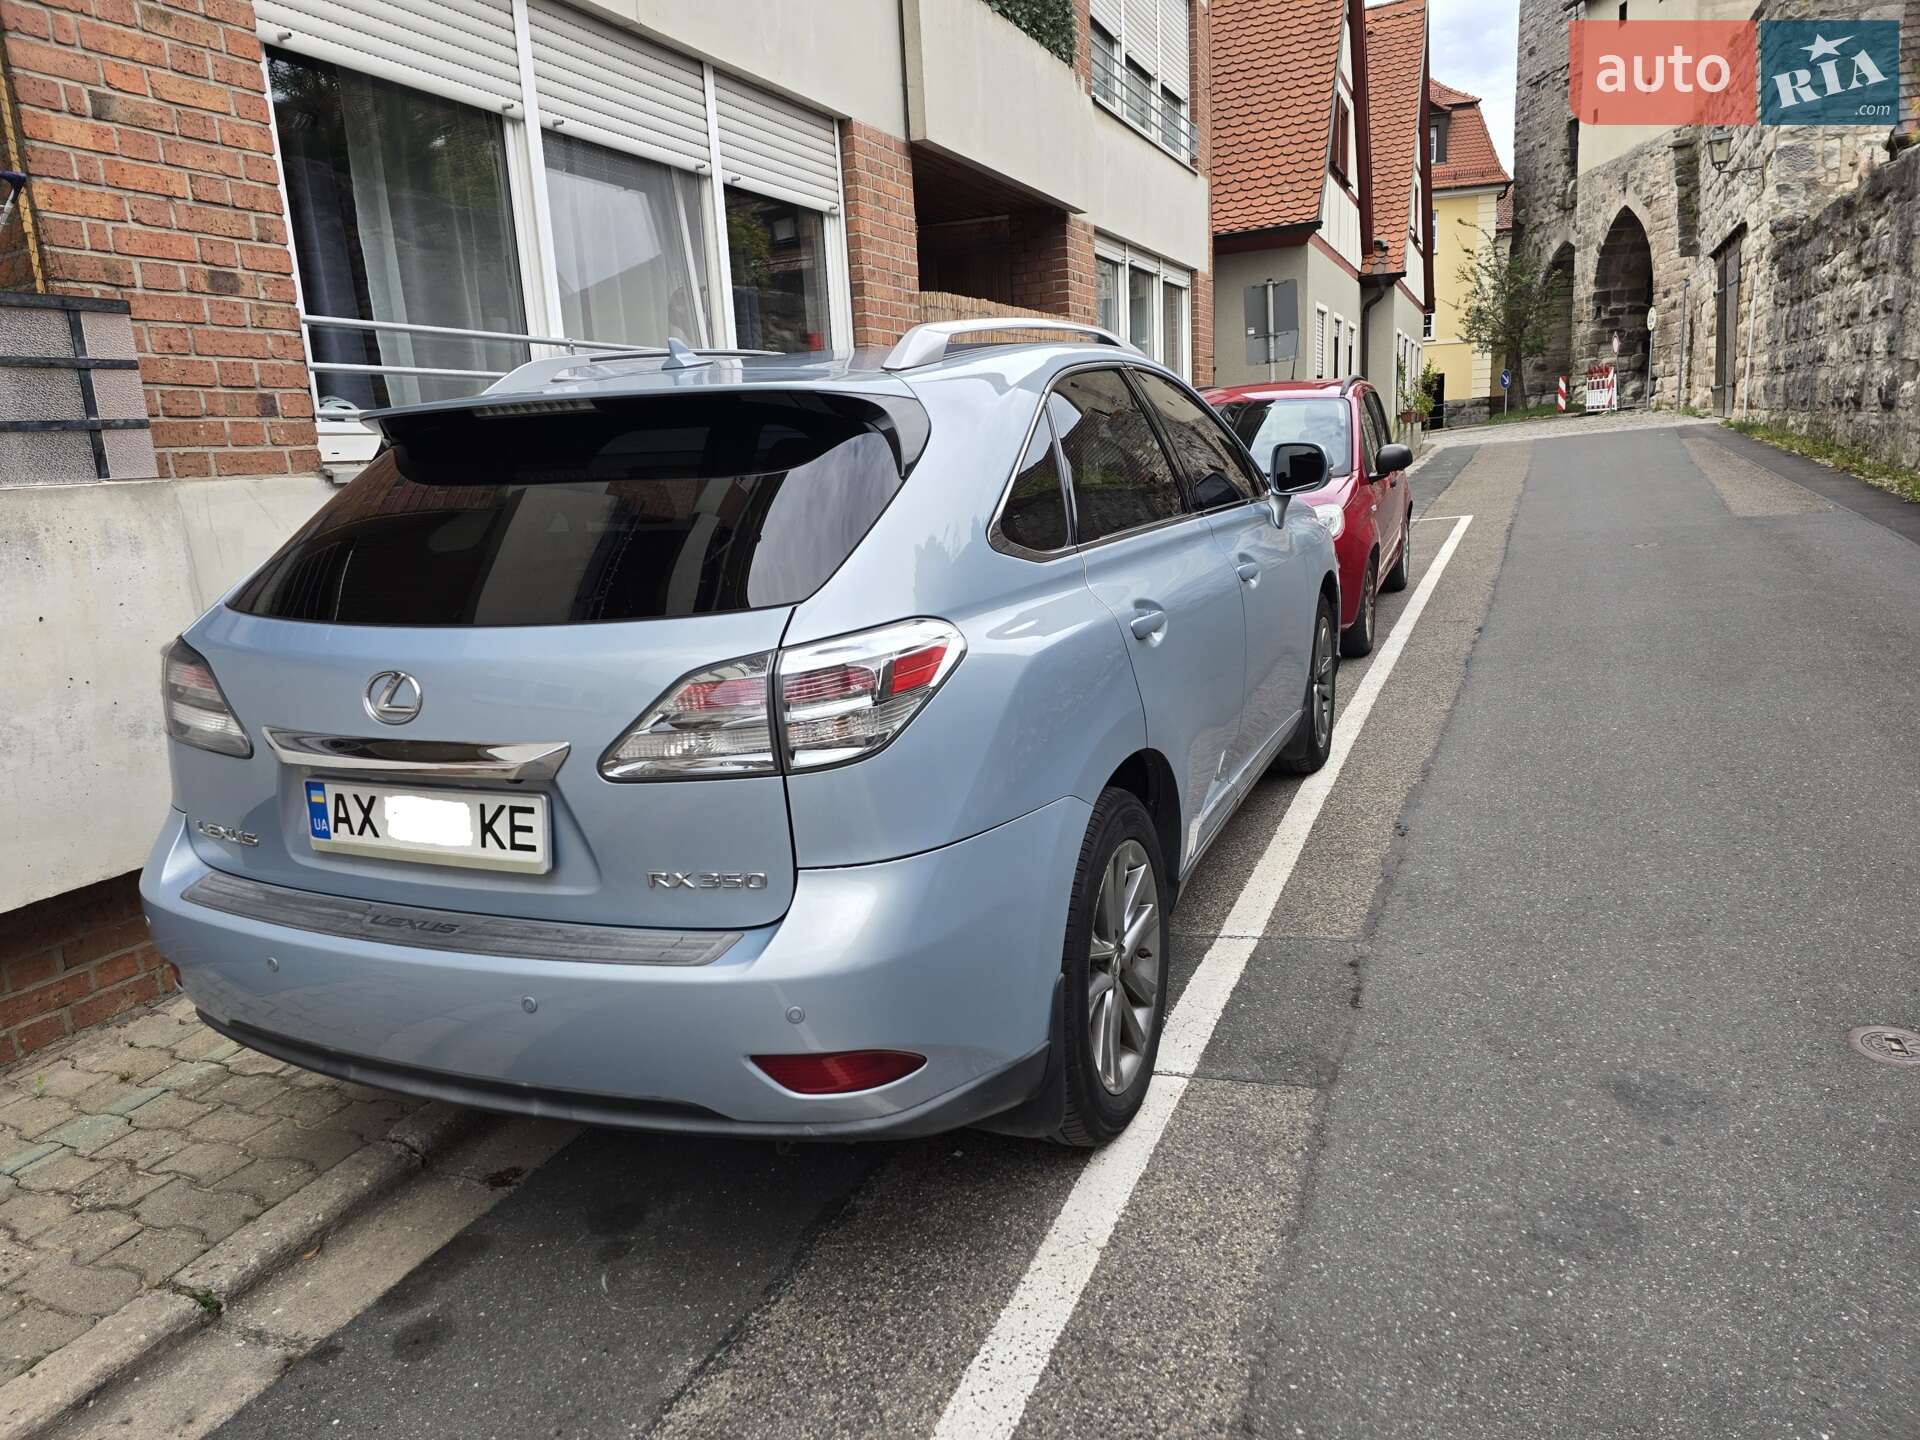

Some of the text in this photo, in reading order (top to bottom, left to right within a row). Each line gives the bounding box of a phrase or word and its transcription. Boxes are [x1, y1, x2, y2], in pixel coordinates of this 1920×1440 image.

[195, 819, 259, 846] LEXUS
[313, 818, 329, 832] UA
[333, 793, 537, 852] AX KE
[369, 915, 460, 934] LEXUS
